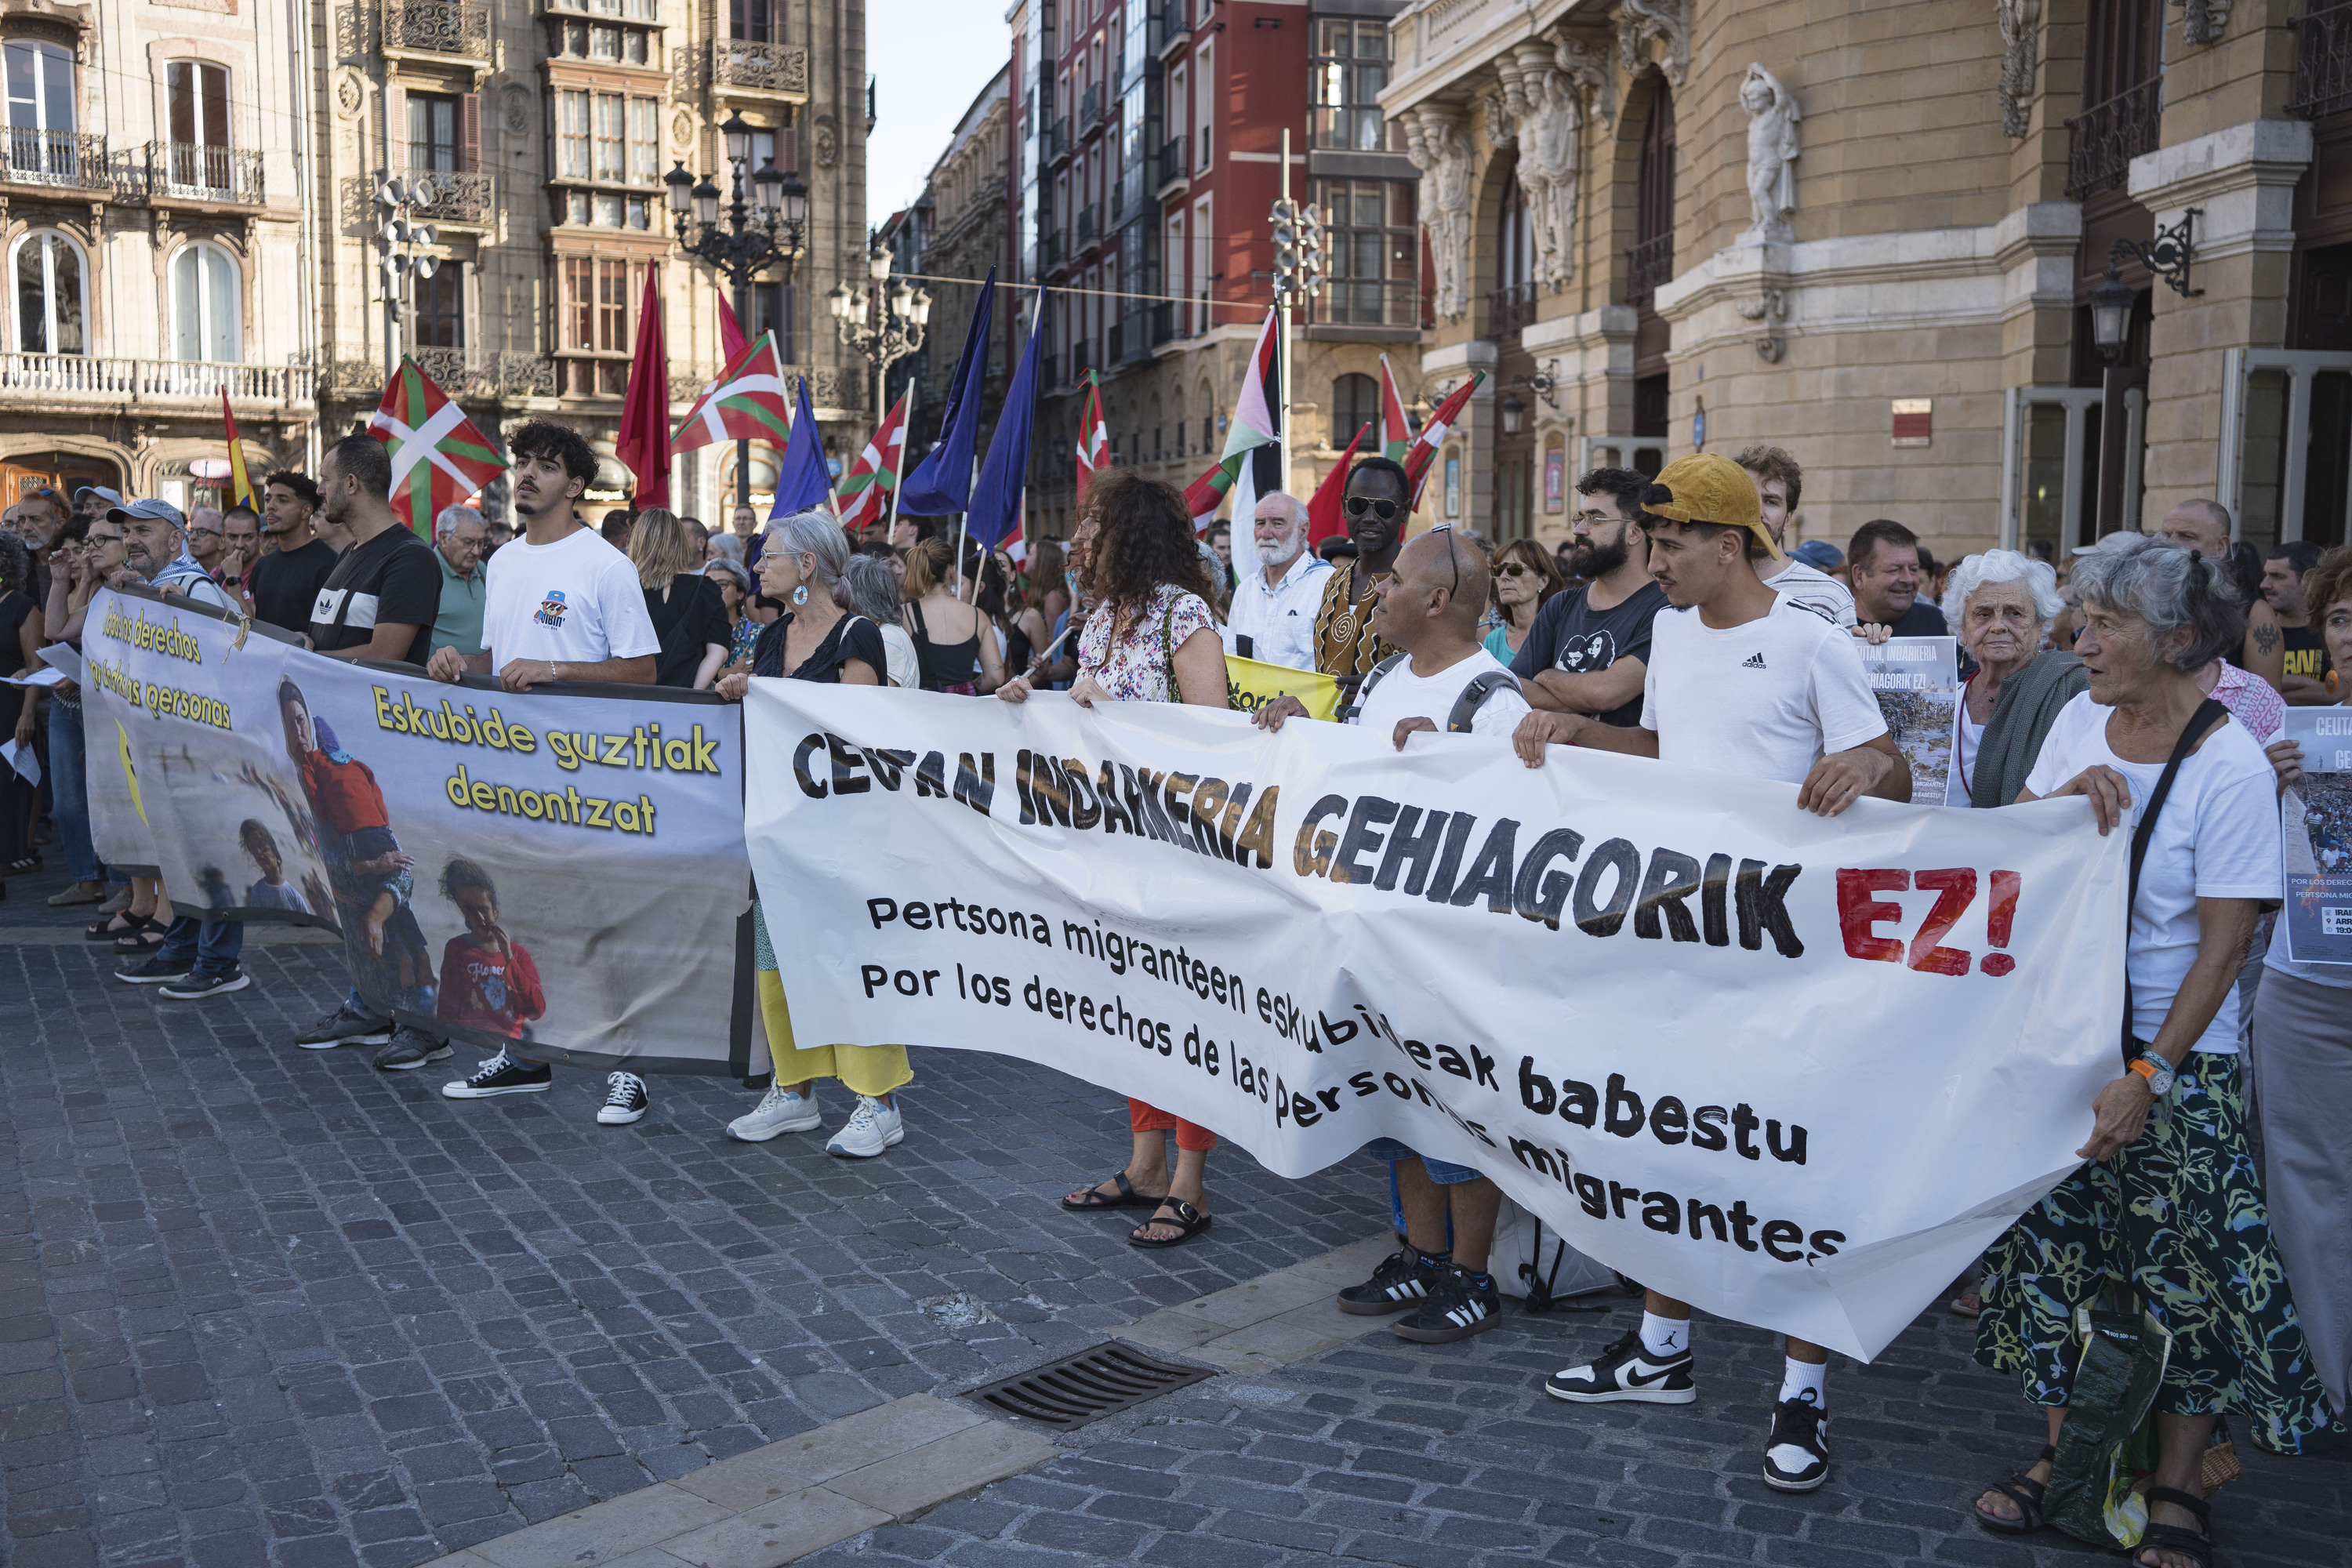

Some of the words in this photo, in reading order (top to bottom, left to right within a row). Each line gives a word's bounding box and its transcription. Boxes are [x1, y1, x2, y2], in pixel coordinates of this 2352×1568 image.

[134, 608, 201, 663] derechos
[1887, 645, 1937, 662] INDARKERIA
[146, 684, 232, 730] personas
[1913, 673, 1926, 689] EZ!
[372, 685, 536, 753] Eskubide
[547, 722, 720, 772] guztiak
[446, 764, 656, 834] denontzat
[793, 732, 996, 818] CEUTAN
[1016, 748, 1280, 869] INDARKERIA
[1294, 793, 1805, 958] GEHIAGORIK
[1835, 867, 2022, 977] EZ!
[1062, 919, 1245, 1014] migranteen
[1256, 986, 1499, 1092] eskubideak
[1519, 1055, 1808, 1165] babestu
[956, 963, 1011, 1007] los
[1023, 975, 1172, 1057] derechos
[1184, 1022, 1220, 1076] de
[1230, 1040, 1269, 1104] las
[1276, 1071, 1497, 1148] personas
[1508, 1135, 1847, 1268] migrantes
